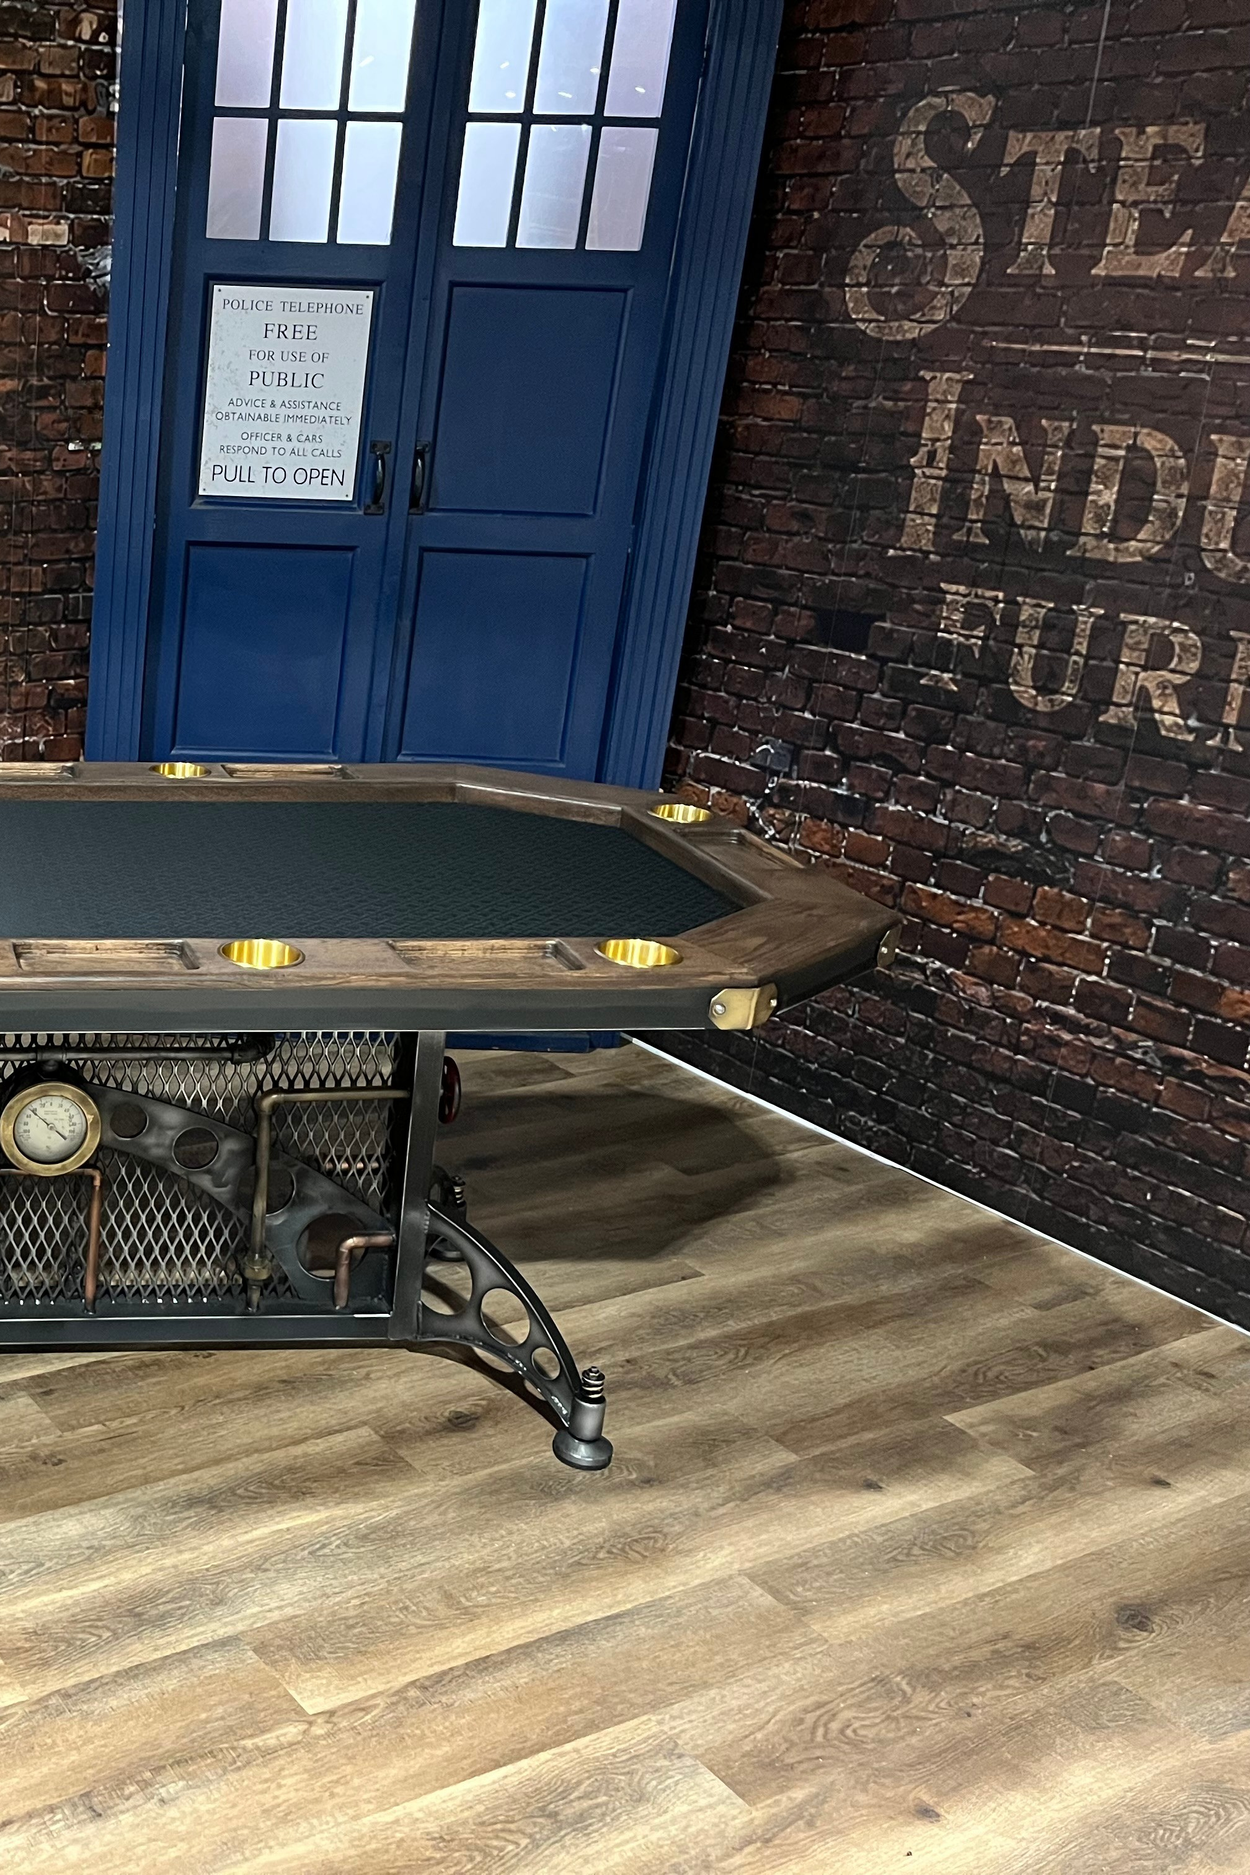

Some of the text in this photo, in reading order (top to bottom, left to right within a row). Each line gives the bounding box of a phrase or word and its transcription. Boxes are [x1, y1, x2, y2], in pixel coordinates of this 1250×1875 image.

[222, 298, 364, 315] POLICE TELEPHONE
[262, 322, 319, 341] FREE
[249, 349, 330, 363] FOR USE OF
[248, 370, 325, 389] PUBLIC
[227, 397, 342, 411] ADVICE & ASSISTANCE
[215, 411, 352, 426] OBTAINABLE IMMEDIATELY
[240, 431, 323, 444] OFFICER & CARS
[219, 445, 342, 458] RESPOND TO ALL CALLS
[211, 464, 346, 487] PULL TO OPEN
